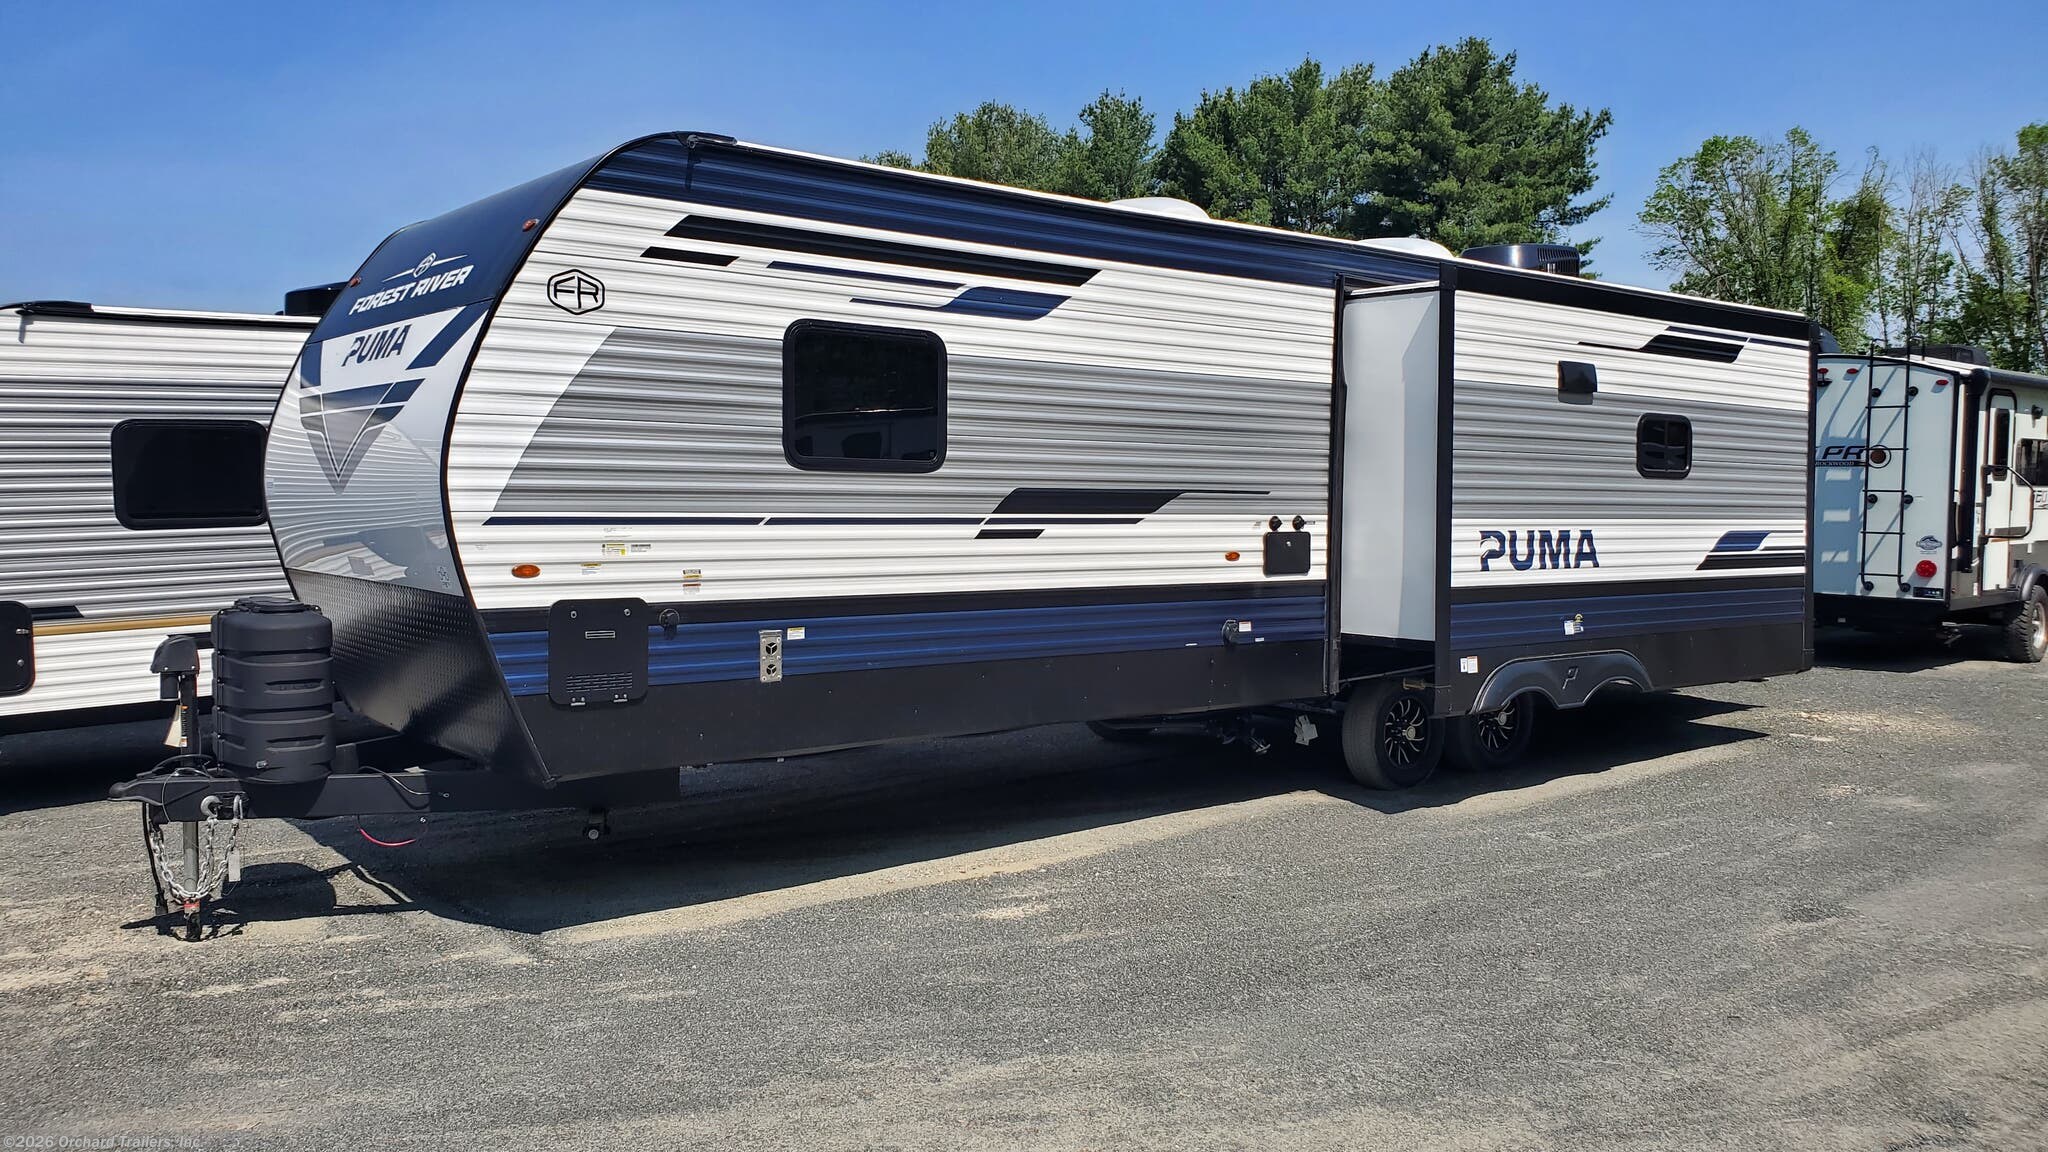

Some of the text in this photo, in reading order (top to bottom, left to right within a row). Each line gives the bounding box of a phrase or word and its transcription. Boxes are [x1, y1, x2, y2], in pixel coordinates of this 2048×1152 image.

[348, 264, 474, 316] FOREST RIVER
[553, 275, 600, 309] FR
[341, 323, 412, 367] PUMA
[1479, 529, 1600, 572] PUMA
